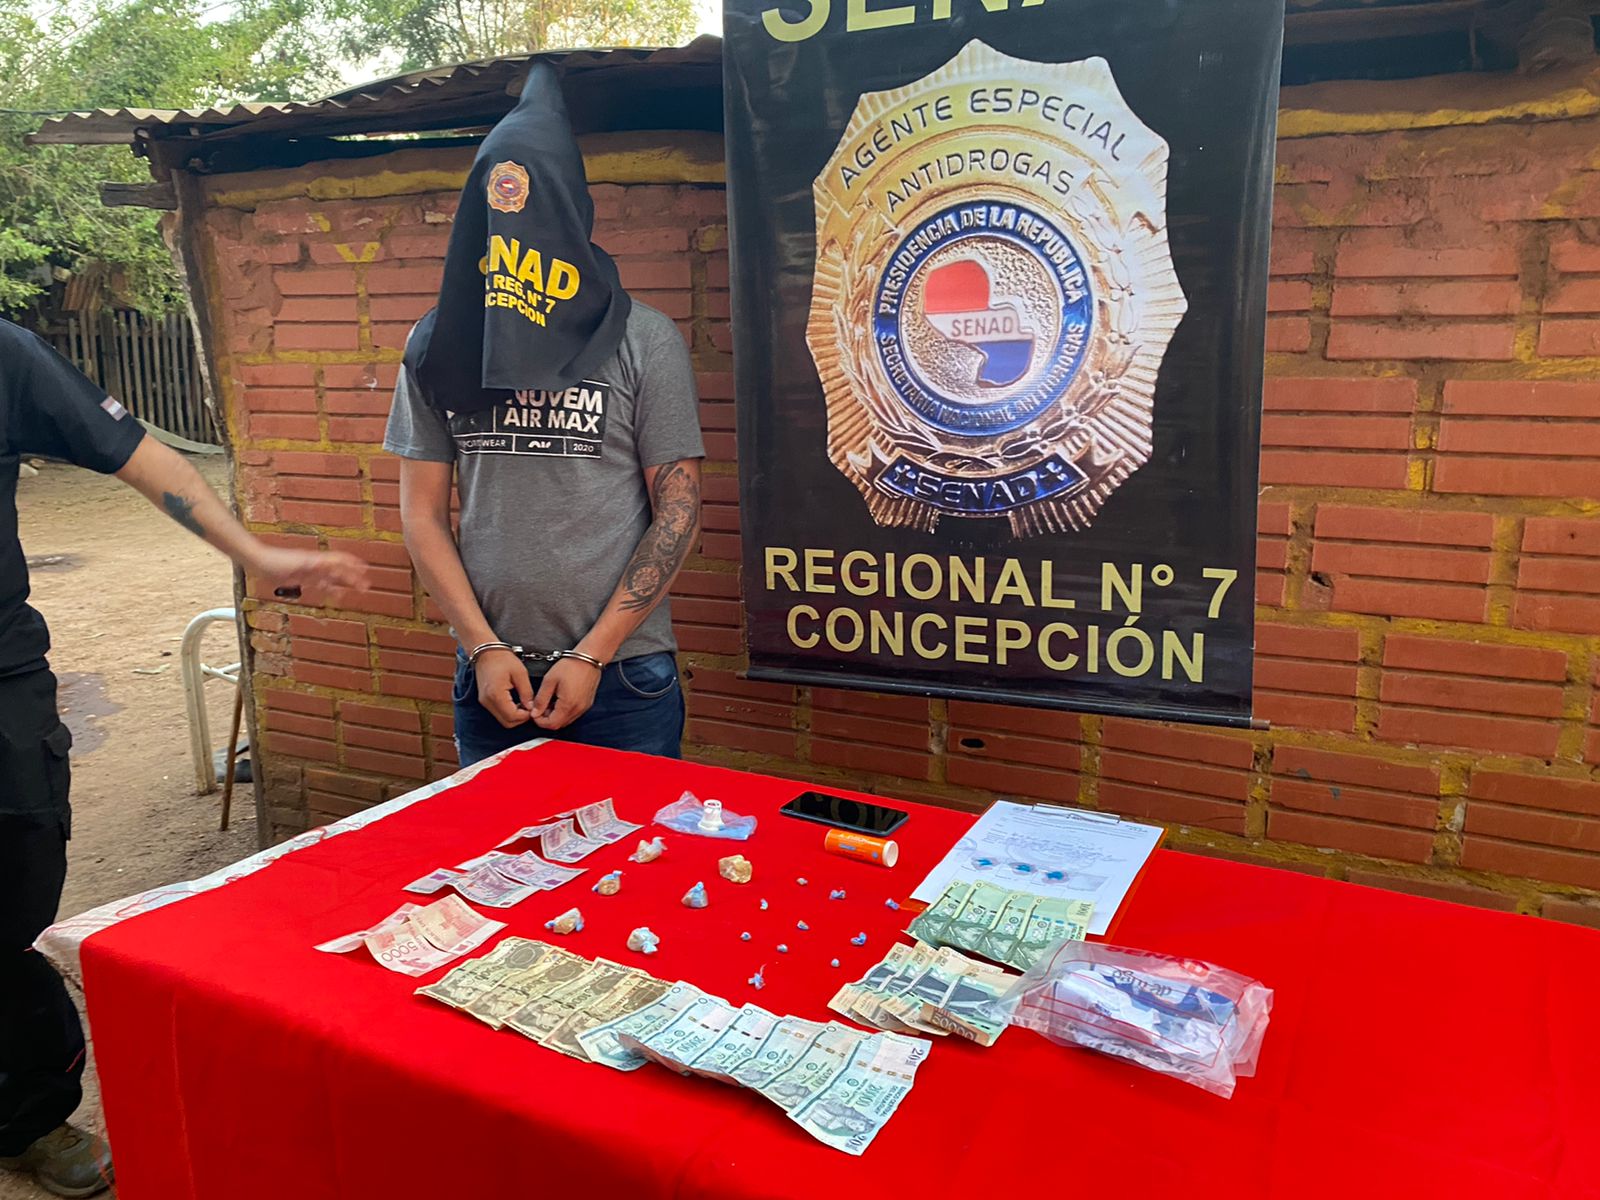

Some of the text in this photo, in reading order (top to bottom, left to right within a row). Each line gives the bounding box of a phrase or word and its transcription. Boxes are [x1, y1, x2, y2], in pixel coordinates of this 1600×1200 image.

[839, 88, 1126, 190] AGENTE ESPECIAL
[886, 149, 1075, 213] ANTIDROGAS
[478, 235, 580, 300] NAD
[878, 211, 960, 315] PRESIDENCIA
[960, 205, 988, 230] DE
[987, 205, 1014, 229] LA
[485, 292, 546, 327] CEPCION
[545, 298, 556, 313] 7
[951, 316, 1014, 338] SENAD
[503, 407, 601, 434] AIR MAX
[573, 443, 594, 453] 2020
[913, 471, 1038, 505] SENAD
[764, 547, 1238, 619] REGIONAL N° 7
[786, 604, 1204, 683] CONCEPCIÓN
[381, 941, 418, 962] 5000
